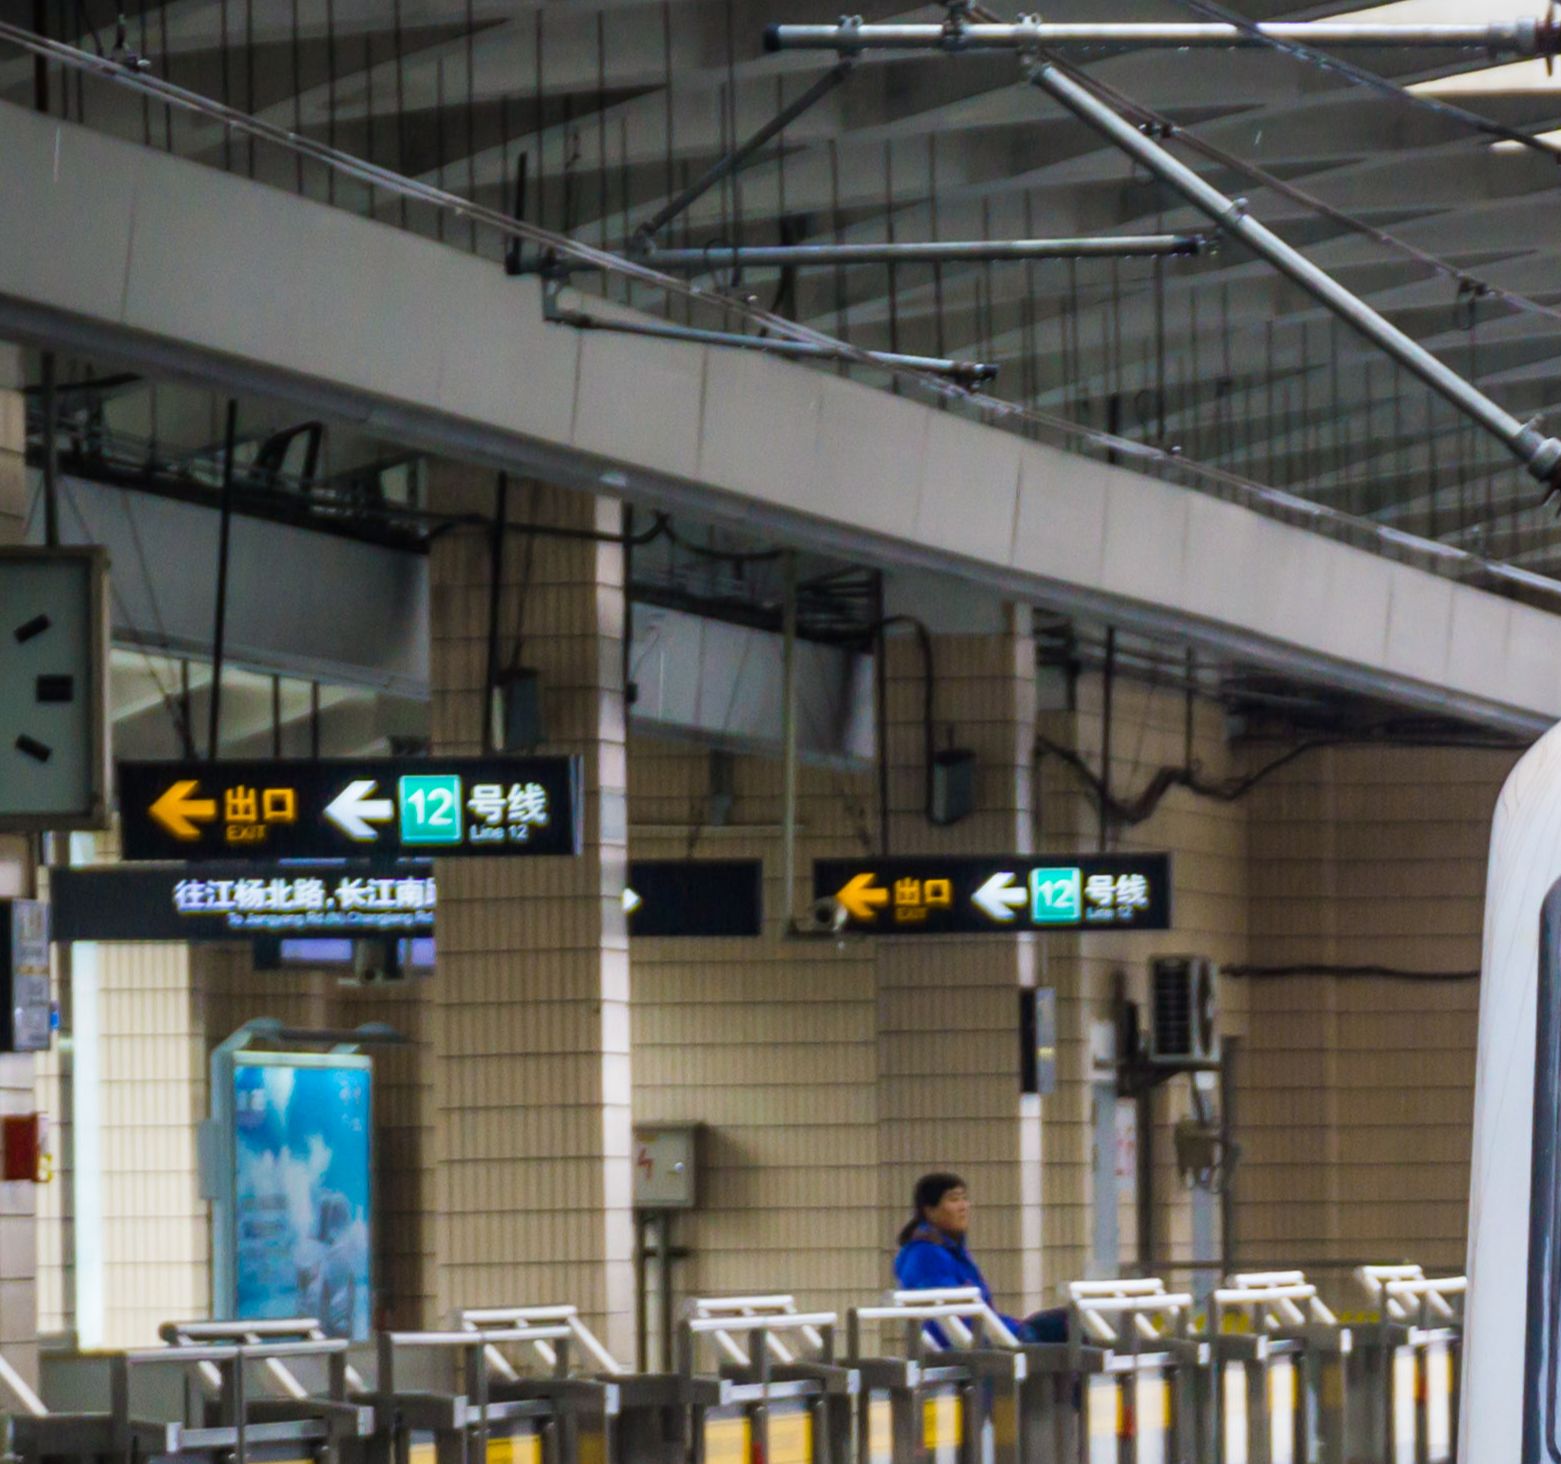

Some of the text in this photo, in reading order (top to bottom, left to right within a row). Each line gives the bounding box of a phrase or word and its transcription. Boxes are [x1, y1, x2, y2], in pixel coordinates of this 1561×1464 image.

[224, 785, 297, 824] 出口
[407, 782, 550, 826] 12 号线
[225, 825, 266, 842] EXIT
[469, 824, 529, 842] Line 12
[894, 876, 951, 907] 出口
[1037, 873, 1149, 909] 12 号线
